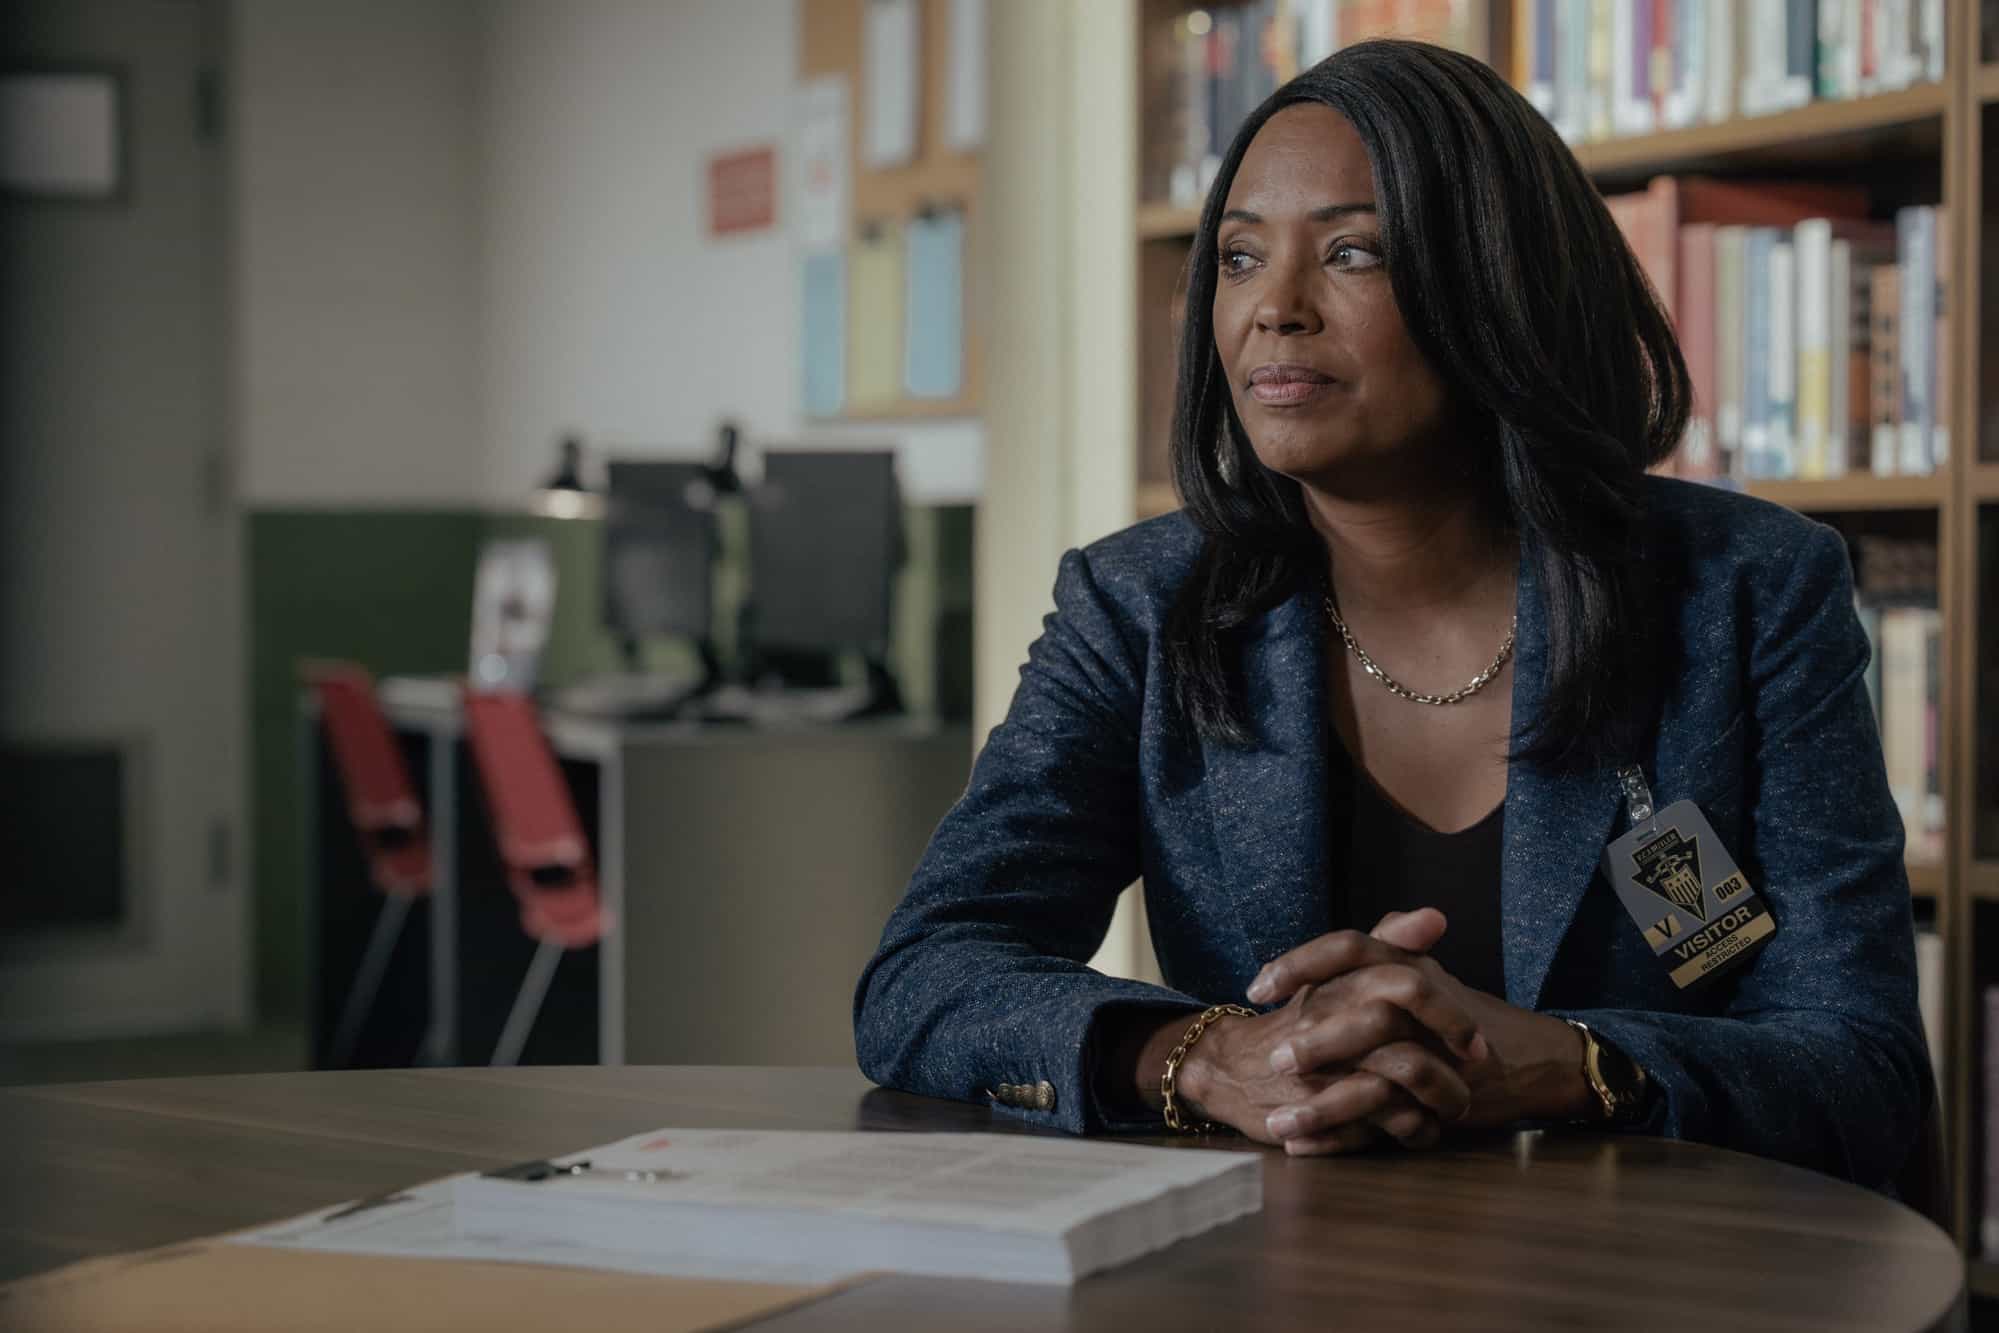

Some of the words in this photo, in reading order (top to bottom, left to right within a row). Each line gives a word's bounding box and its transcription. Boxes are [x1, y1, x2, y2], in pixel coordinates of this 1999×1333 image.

[1715, 877, 1742, 900] 003
[1654, 917, 1672, 938] V
[1674, 906, 1752, 959] VISITOR
[1701, 937, 1752, 971] RESTRICTED
[1706, 934, 1739, 958] ACCESS
